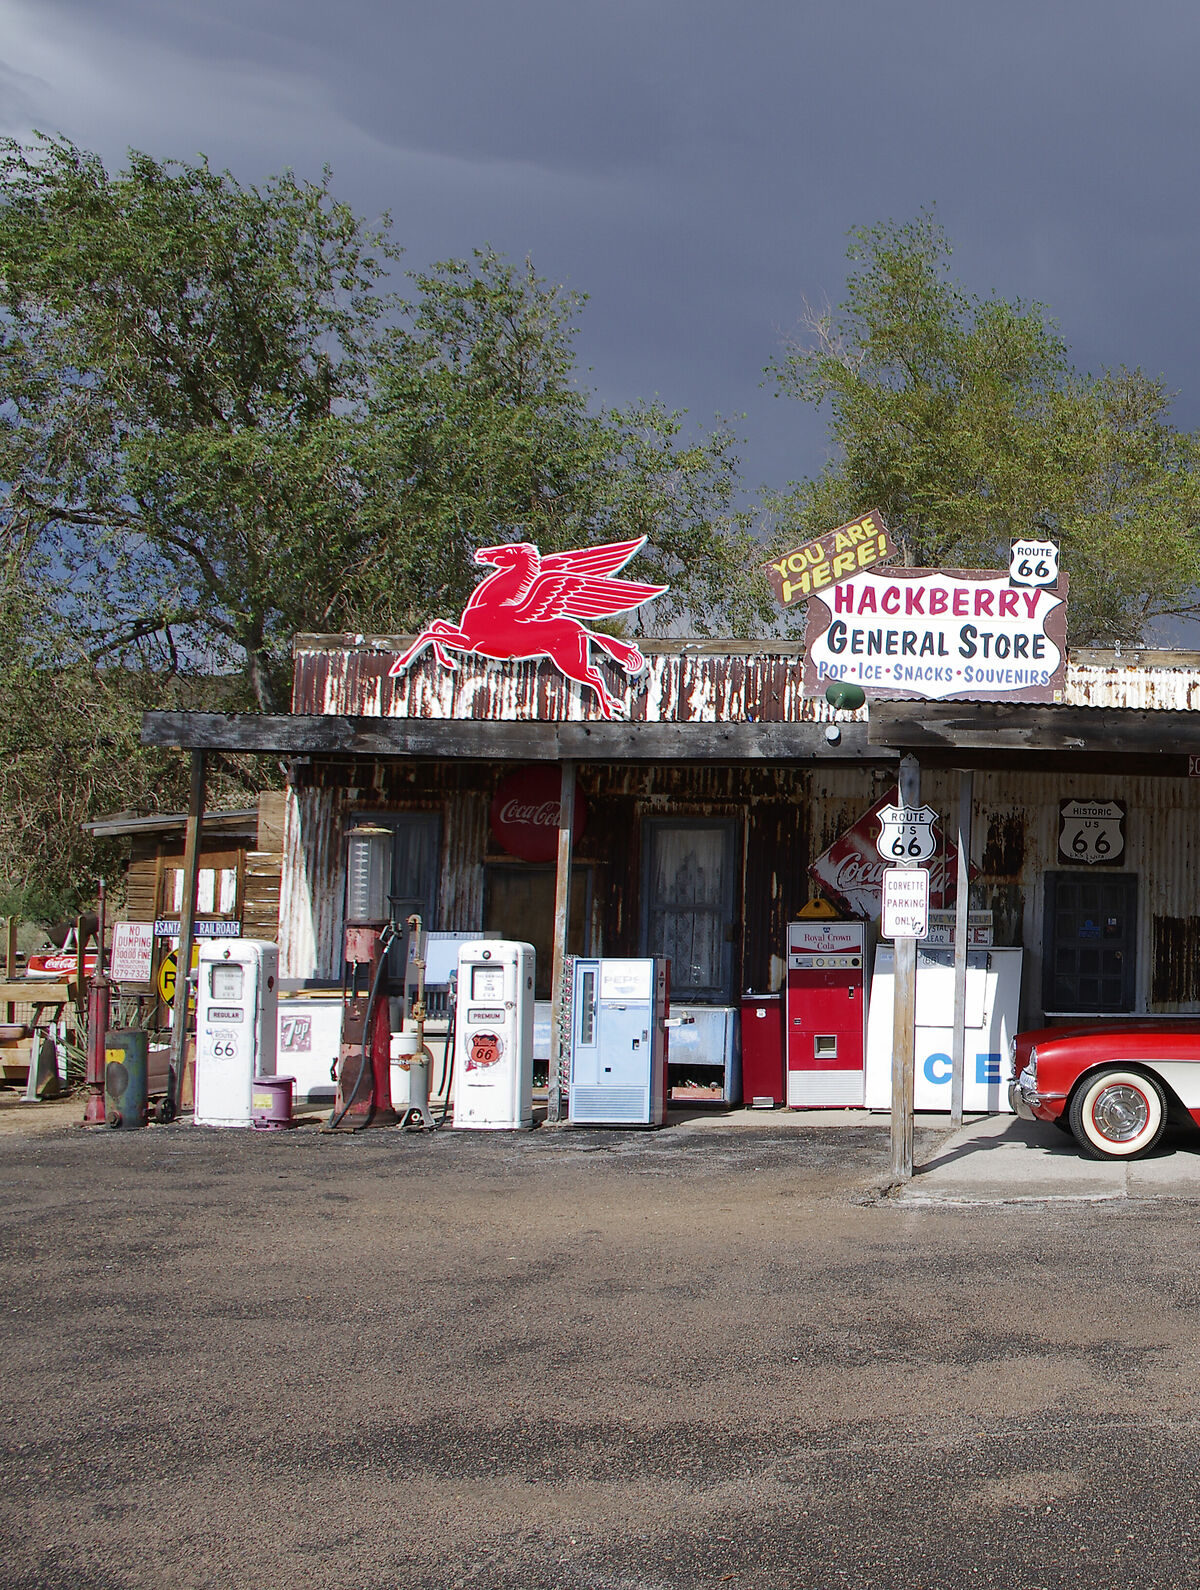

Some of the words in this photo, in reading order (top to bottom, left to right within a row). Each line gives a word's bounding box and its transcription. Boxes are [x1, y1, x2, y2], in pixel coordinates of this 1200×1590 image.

[772, 543, 825, 578] YOU
[835, 517, 878, 553] ARE
[1017, 547, 1052, 557] ROUTE
[782, 534, 887, 603] HERE!
[1018, 559, 1049, 577] 66
[834, 584, 1041, 619] HACKBERRY
[827, 620, 949, 657] GENERAL
[958, 624, 1045, 659] STORE
[964, 665, 1050, 685] SOUVENIRS
[891, 812, 925, 822] ROUTE
[1073, 808, 1113, 816] HISTORIC
[897, 826, 917, 835] US
[891, 837, 922, 857] 66
[1072, 830, 1110, 854] 66
[888, 881, 924, 891] CORVETTE
[887, 899, 924, 908] PARKING
[895, 916, 916, 925] ONLY
[129, 926, 140, 936] NO
[200, 922, 237, 934] RAILROAD
[118, 936, 151, 947] DUMPING
[804, 934, 824, 942] Royal
[828, 934, 851, 942] Crown
[817, 942, 834, 950] Cola
[115, 968, 150, 978] 979-7325
[214, 1041, 235, 1056] 66
[476, 1048, 493, 1060] 66
